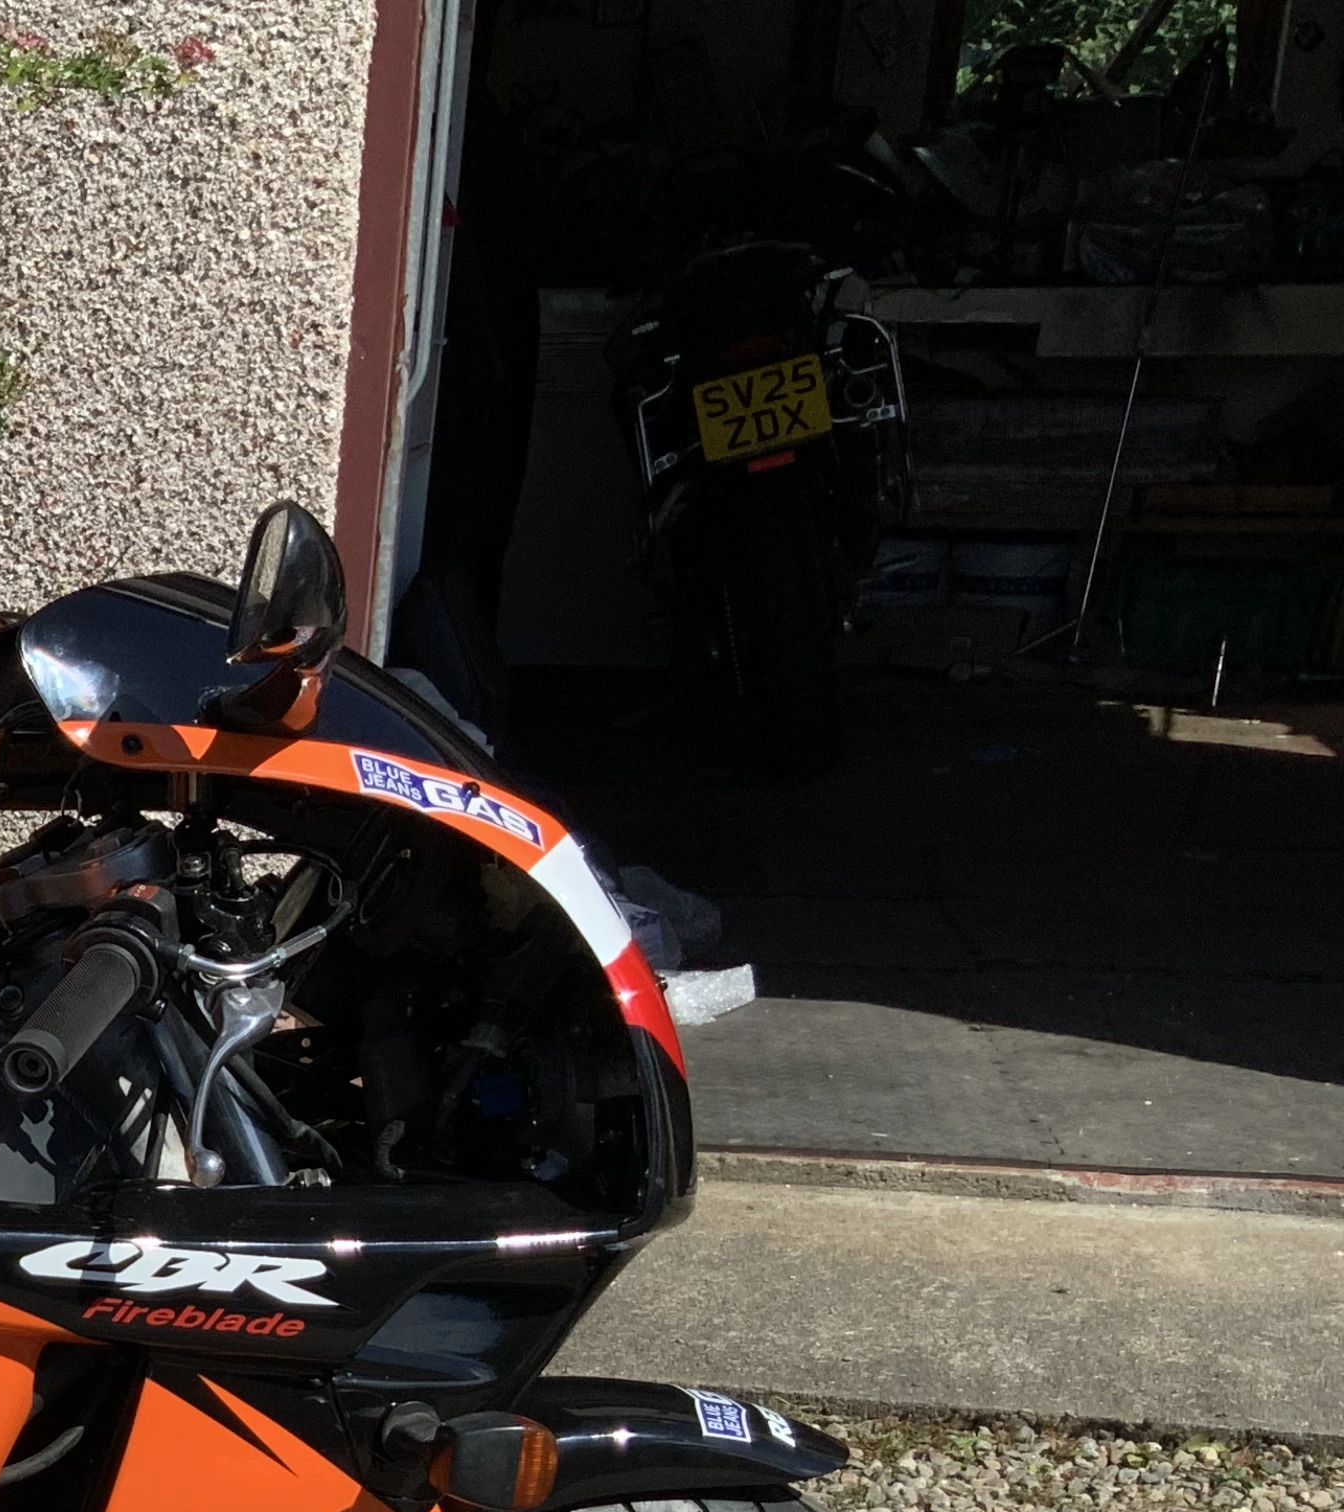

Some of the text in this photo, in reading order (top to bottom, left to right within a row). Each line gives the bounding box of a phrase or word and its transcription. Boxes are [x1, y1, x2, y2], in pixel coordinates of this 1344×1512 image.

[702, 361, 817, 418] SV25
[722, 400, 810, 450] ZDX
[362, 757, 411, 784] BLUE
[364, 773, 423, 801] JEANS
[422, 779, 535, 842] GAS
[19, 1241, 340, 1307] CBR
[83, 1297, 305, 1339] Fireblade
